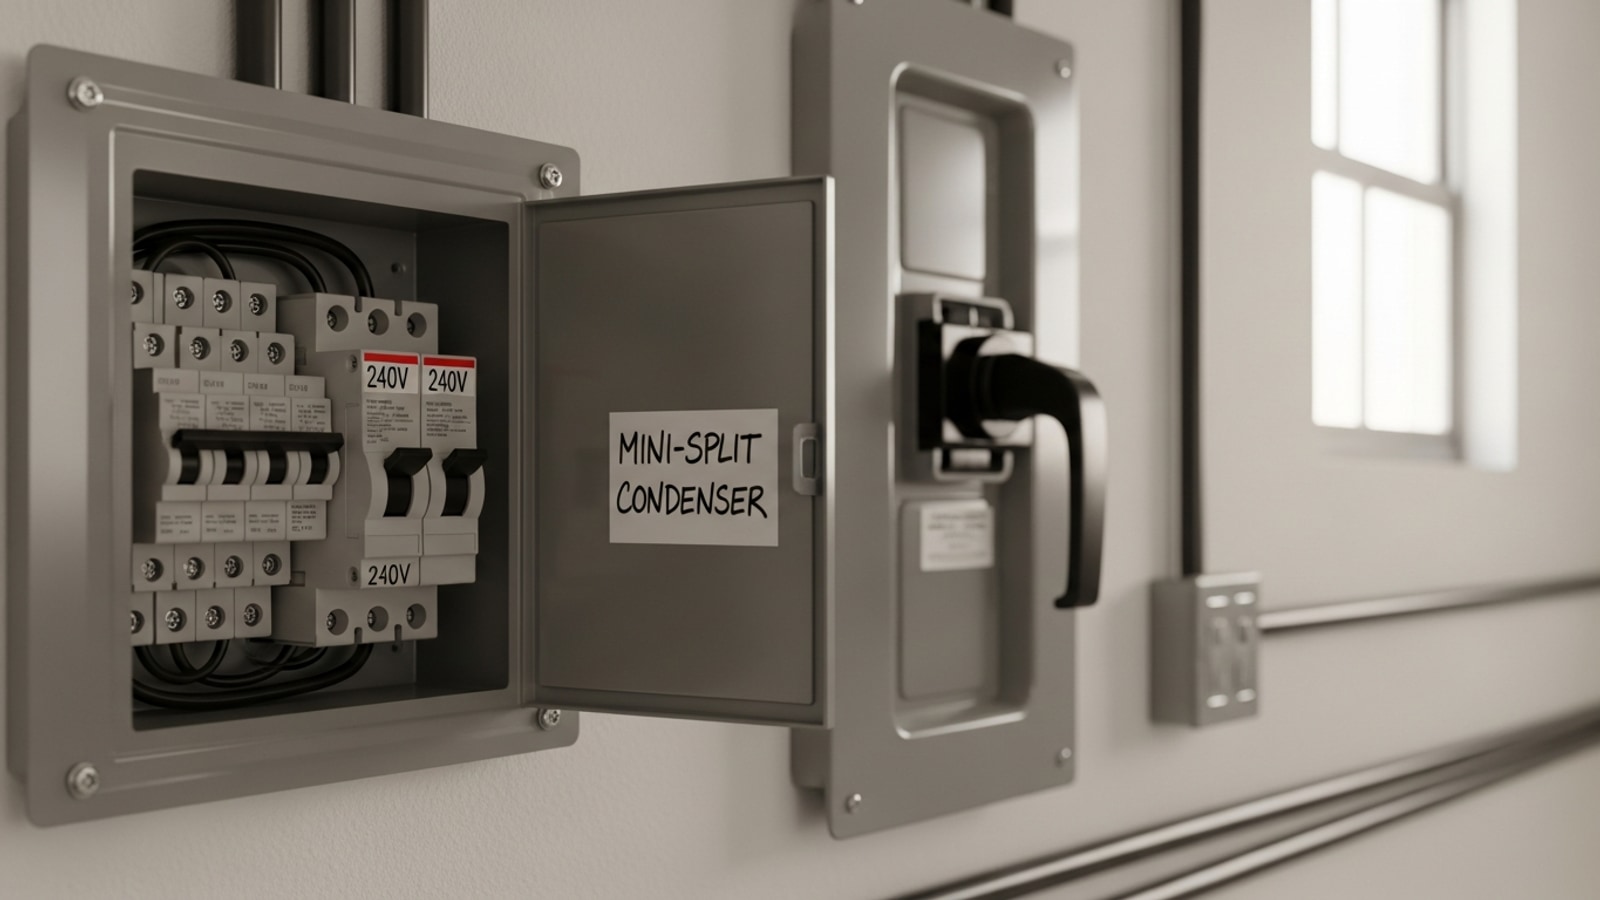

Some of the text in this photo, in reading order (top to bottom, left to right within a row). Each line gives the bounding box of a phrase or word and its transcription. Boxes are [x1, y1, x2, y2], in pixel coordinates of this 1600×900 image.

[367, 365, 409, 389] 240V
[428, 368, 468, 392] 240V
[619, 430, 762, 465] MINI-SPLIT
[617, 481, 768, 519] CONDENSER
[367, 563, 411, 585] 240V
